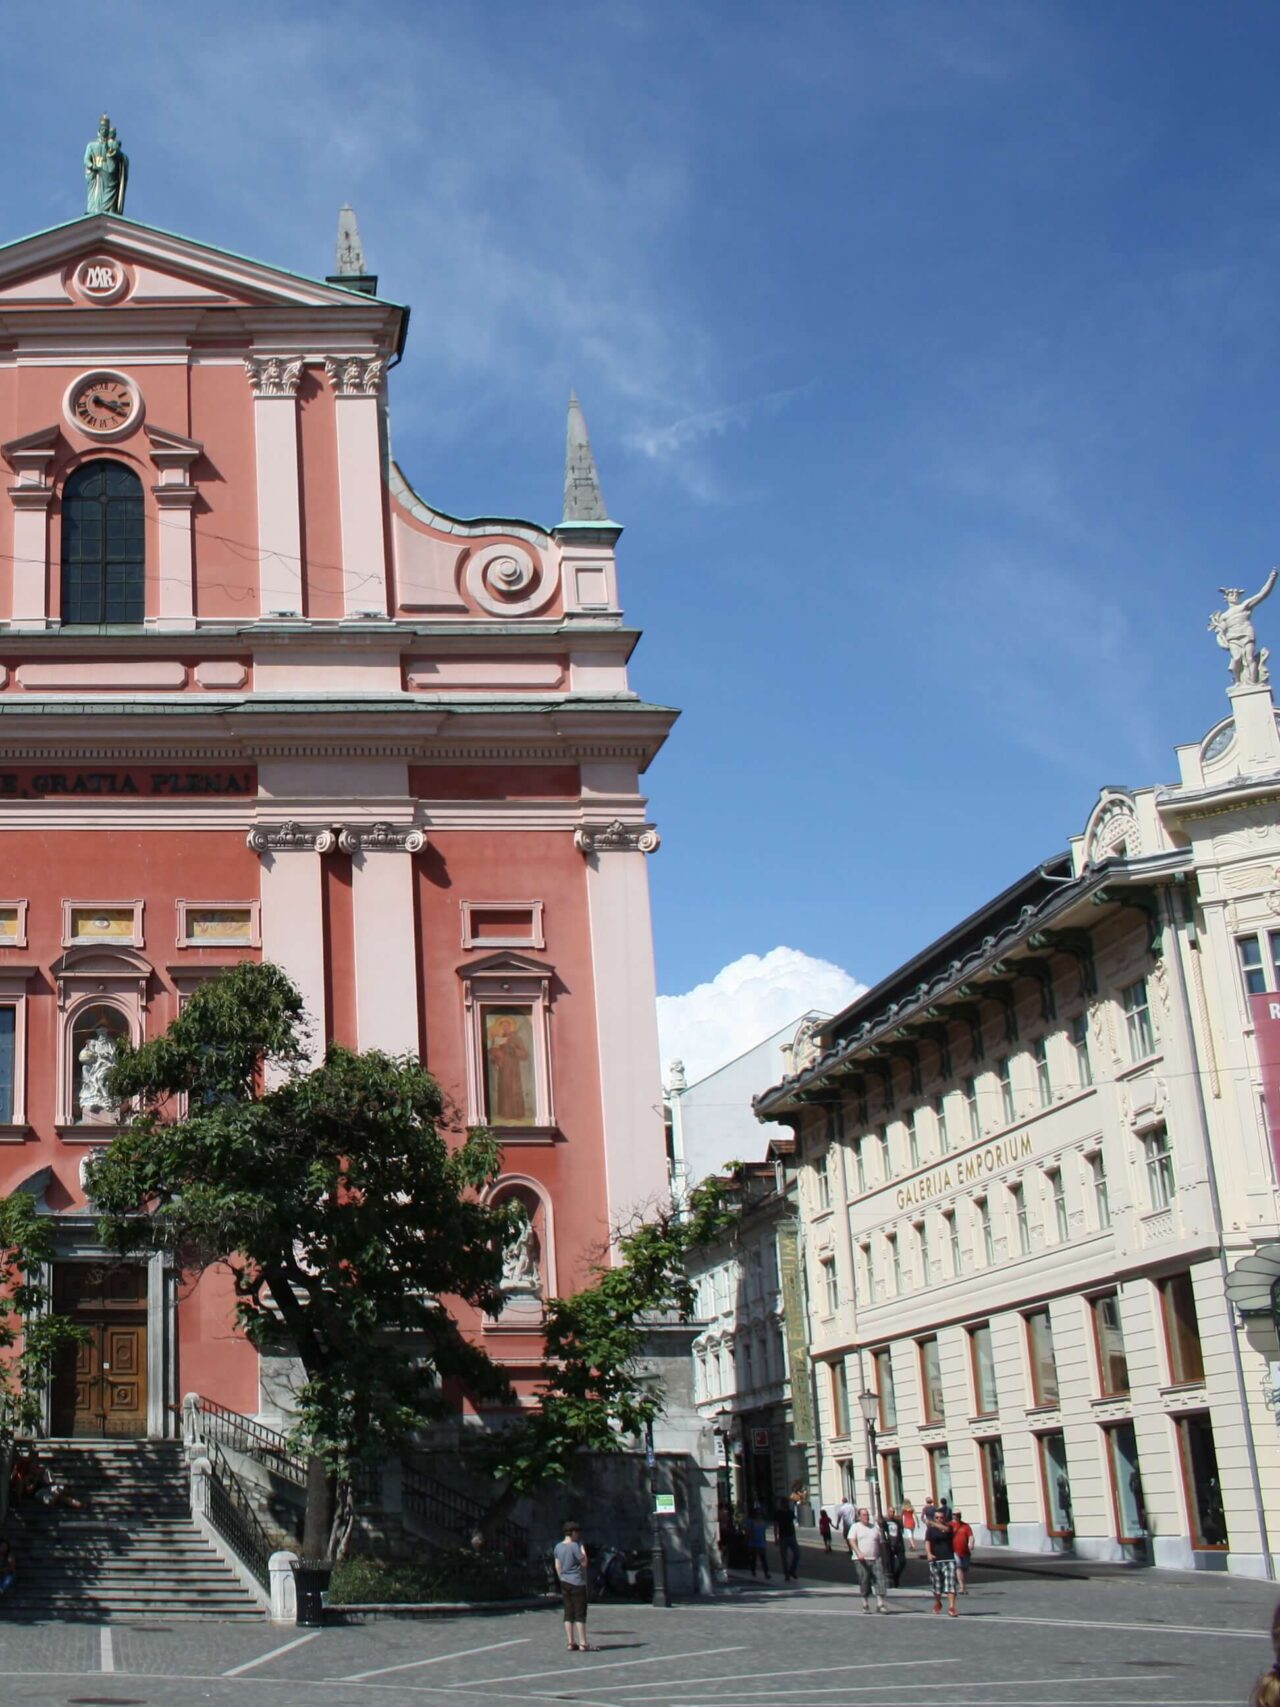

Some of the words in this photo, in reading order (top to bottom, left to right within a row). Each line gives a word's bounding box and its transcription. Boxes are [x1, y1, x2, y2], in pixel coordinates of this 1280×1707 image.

[31, 774, 138, 792] GRATIA
[897, 1168, 952, 1210] GALERIJA
[957, 1131, 1033, 1184] EMPORIUM
[781, 1238, 803, 1340] EMIUM
